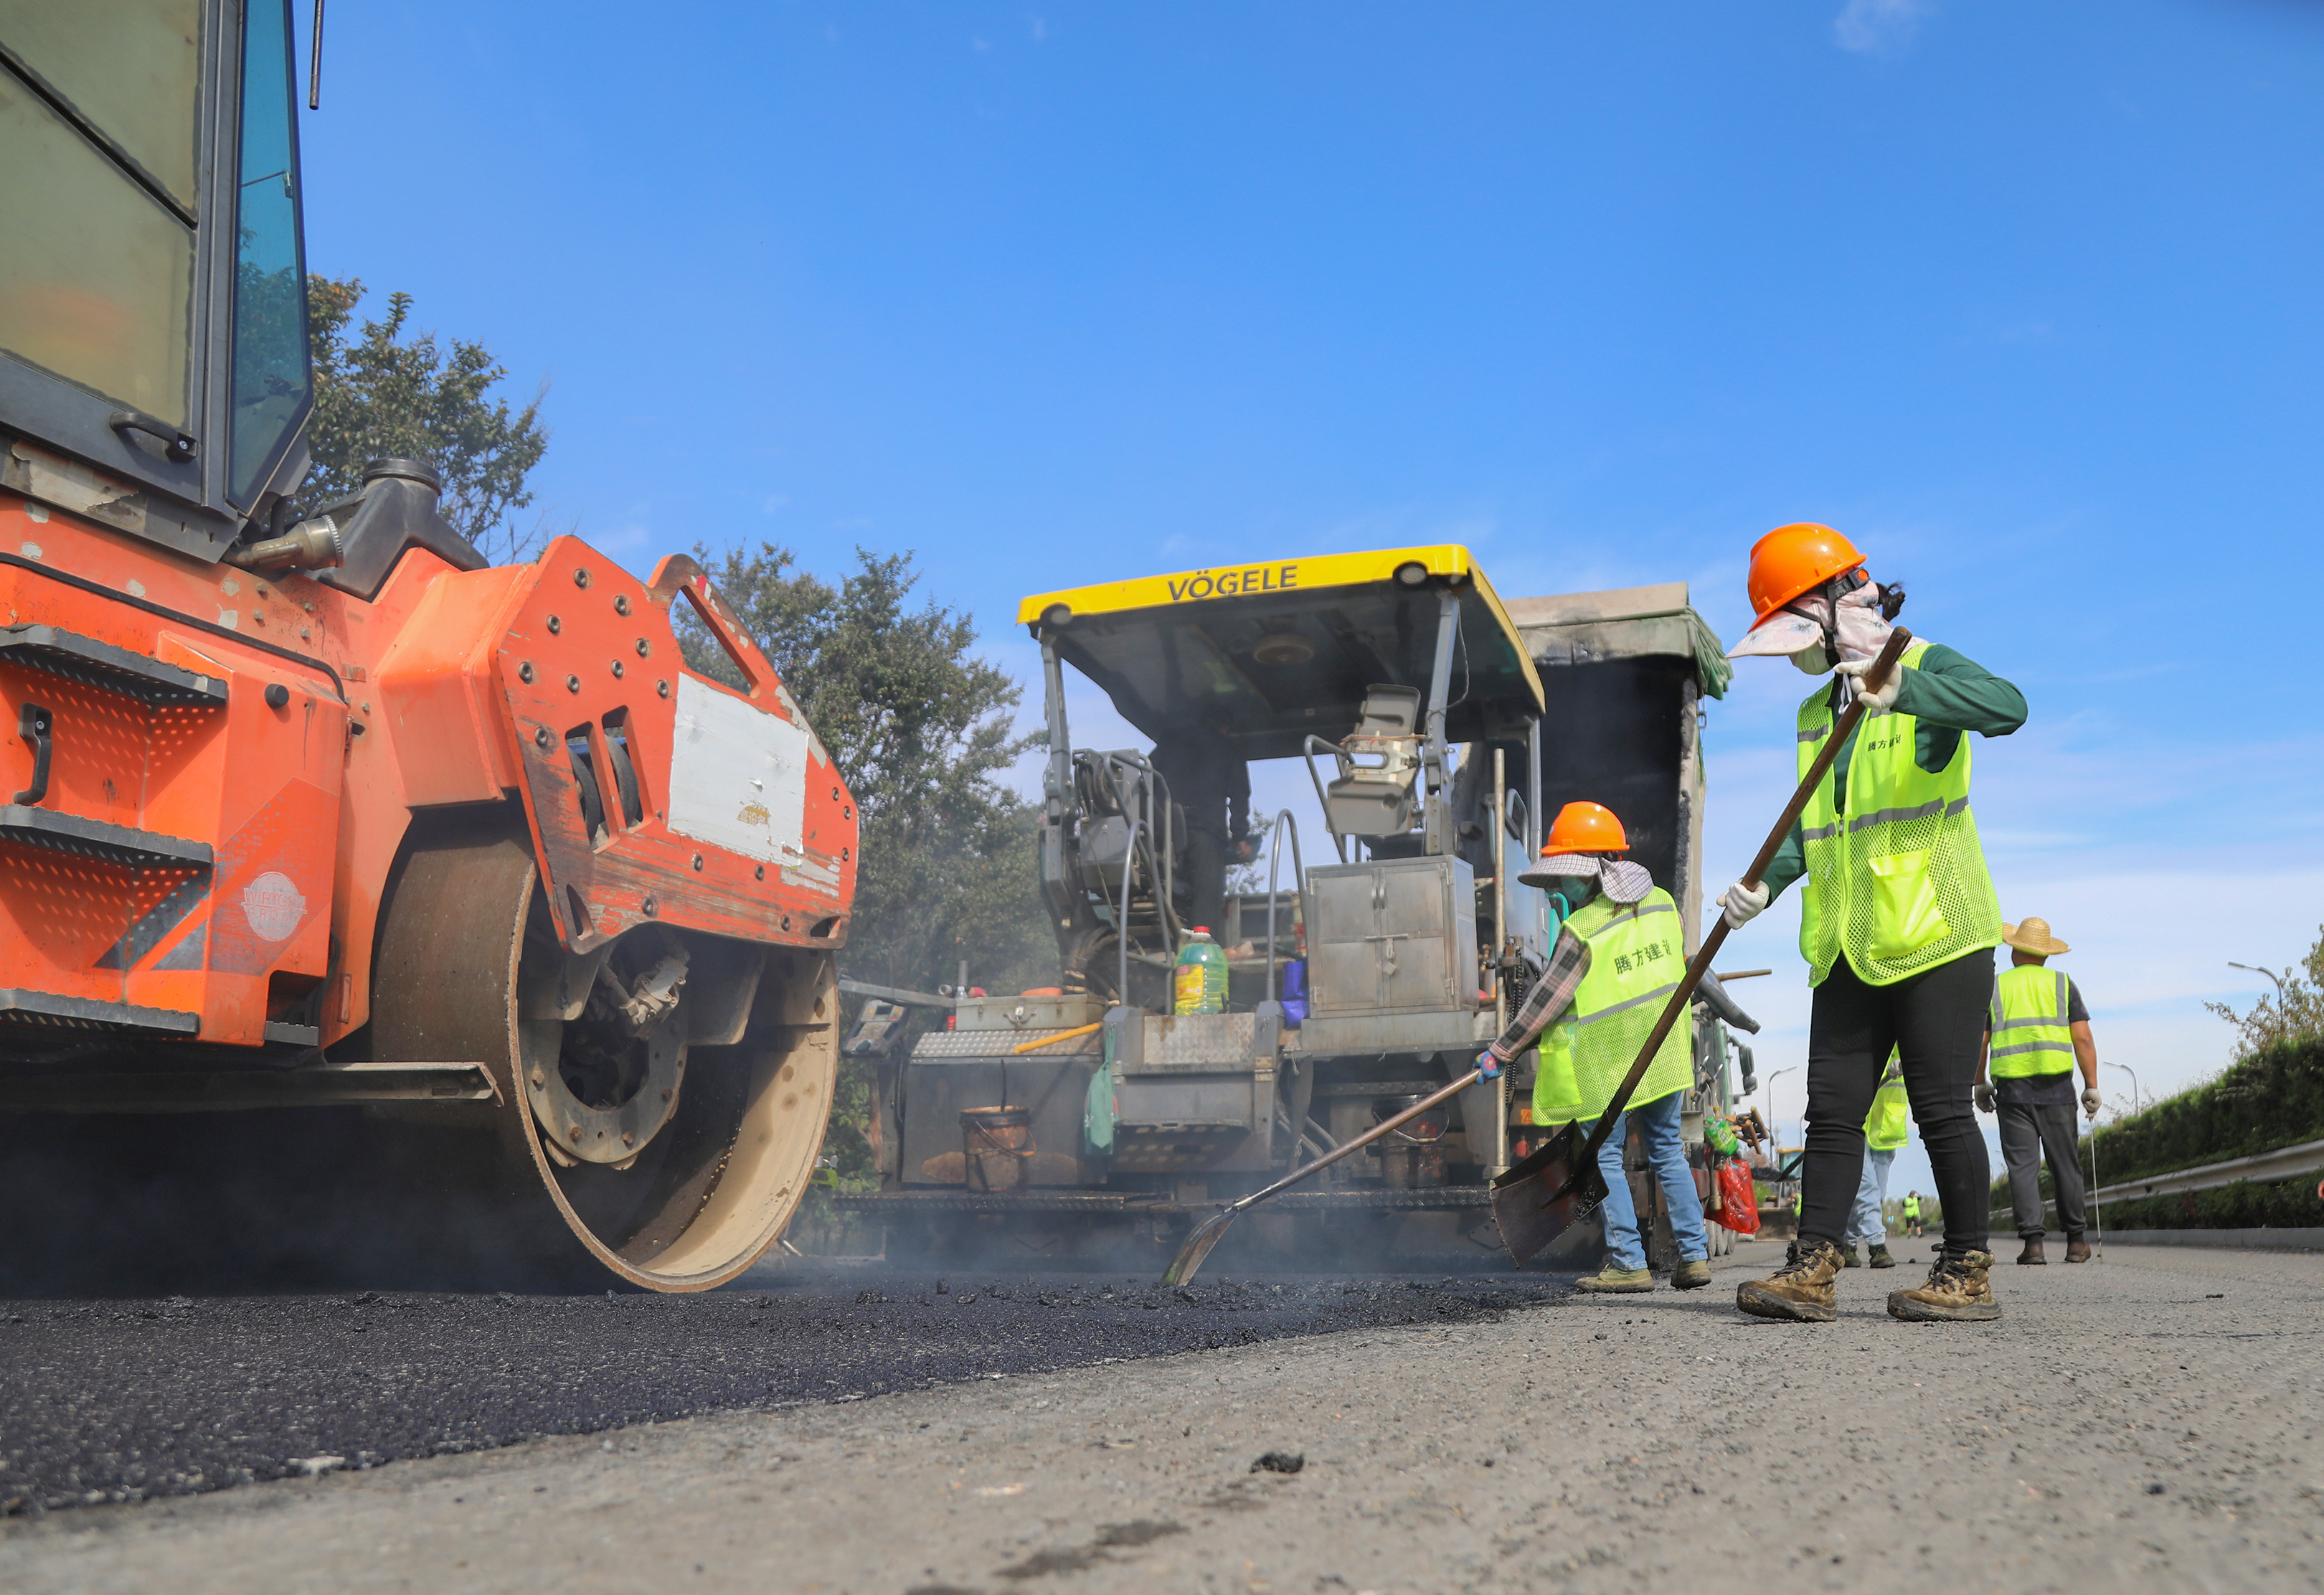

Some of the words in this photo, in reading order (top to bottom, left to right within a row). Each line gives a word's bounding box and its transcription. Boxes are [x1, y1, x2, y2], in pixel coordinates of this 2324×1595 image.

[1168, 564, 1298, 601] VÖGELE
[245, 889, 306, 911] WIRTGEN
[247, 906, 301, 923] GROUP
